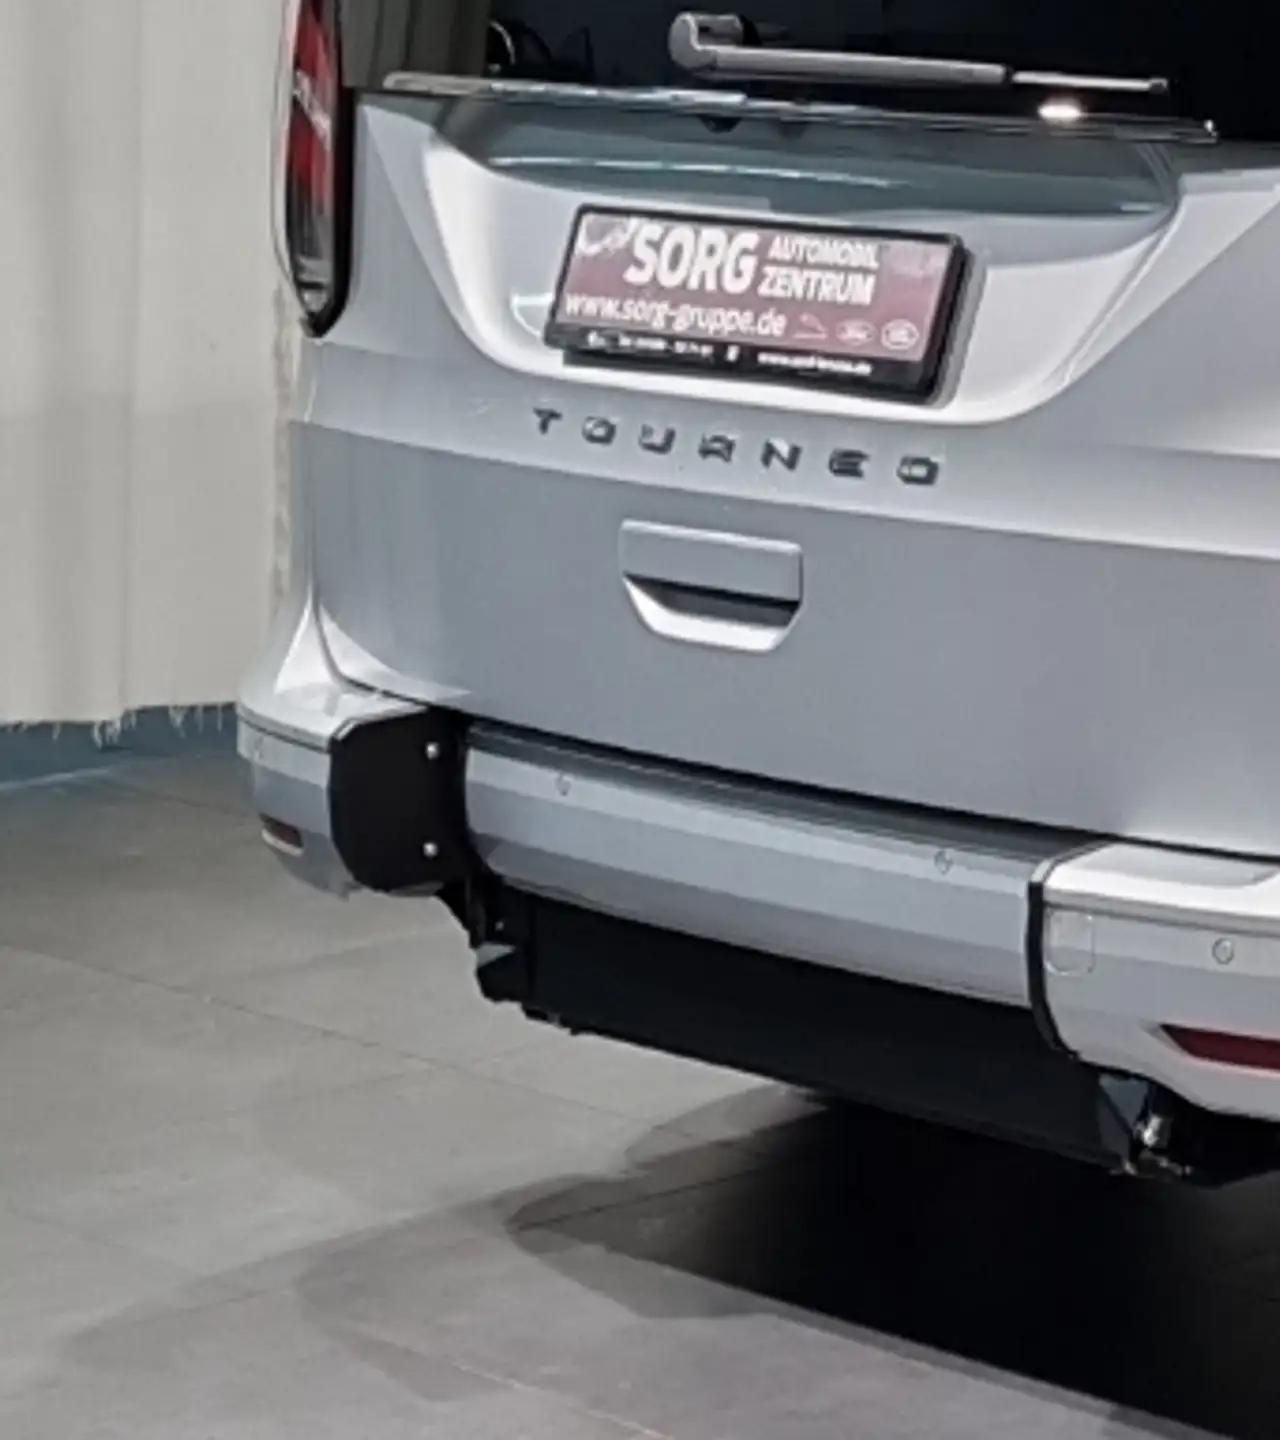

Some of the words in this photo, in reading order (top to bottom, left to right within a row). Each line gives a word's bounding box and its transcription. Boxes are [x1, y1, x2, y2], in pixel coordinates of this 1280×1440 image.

[622, 222, 761, 294] SORG
[756, 266, 877, 306] ZENTRUM
[564, 293, 788, 337] www.sorg-gruppe.de
[532, 406, 943, 487] TOURNEO
